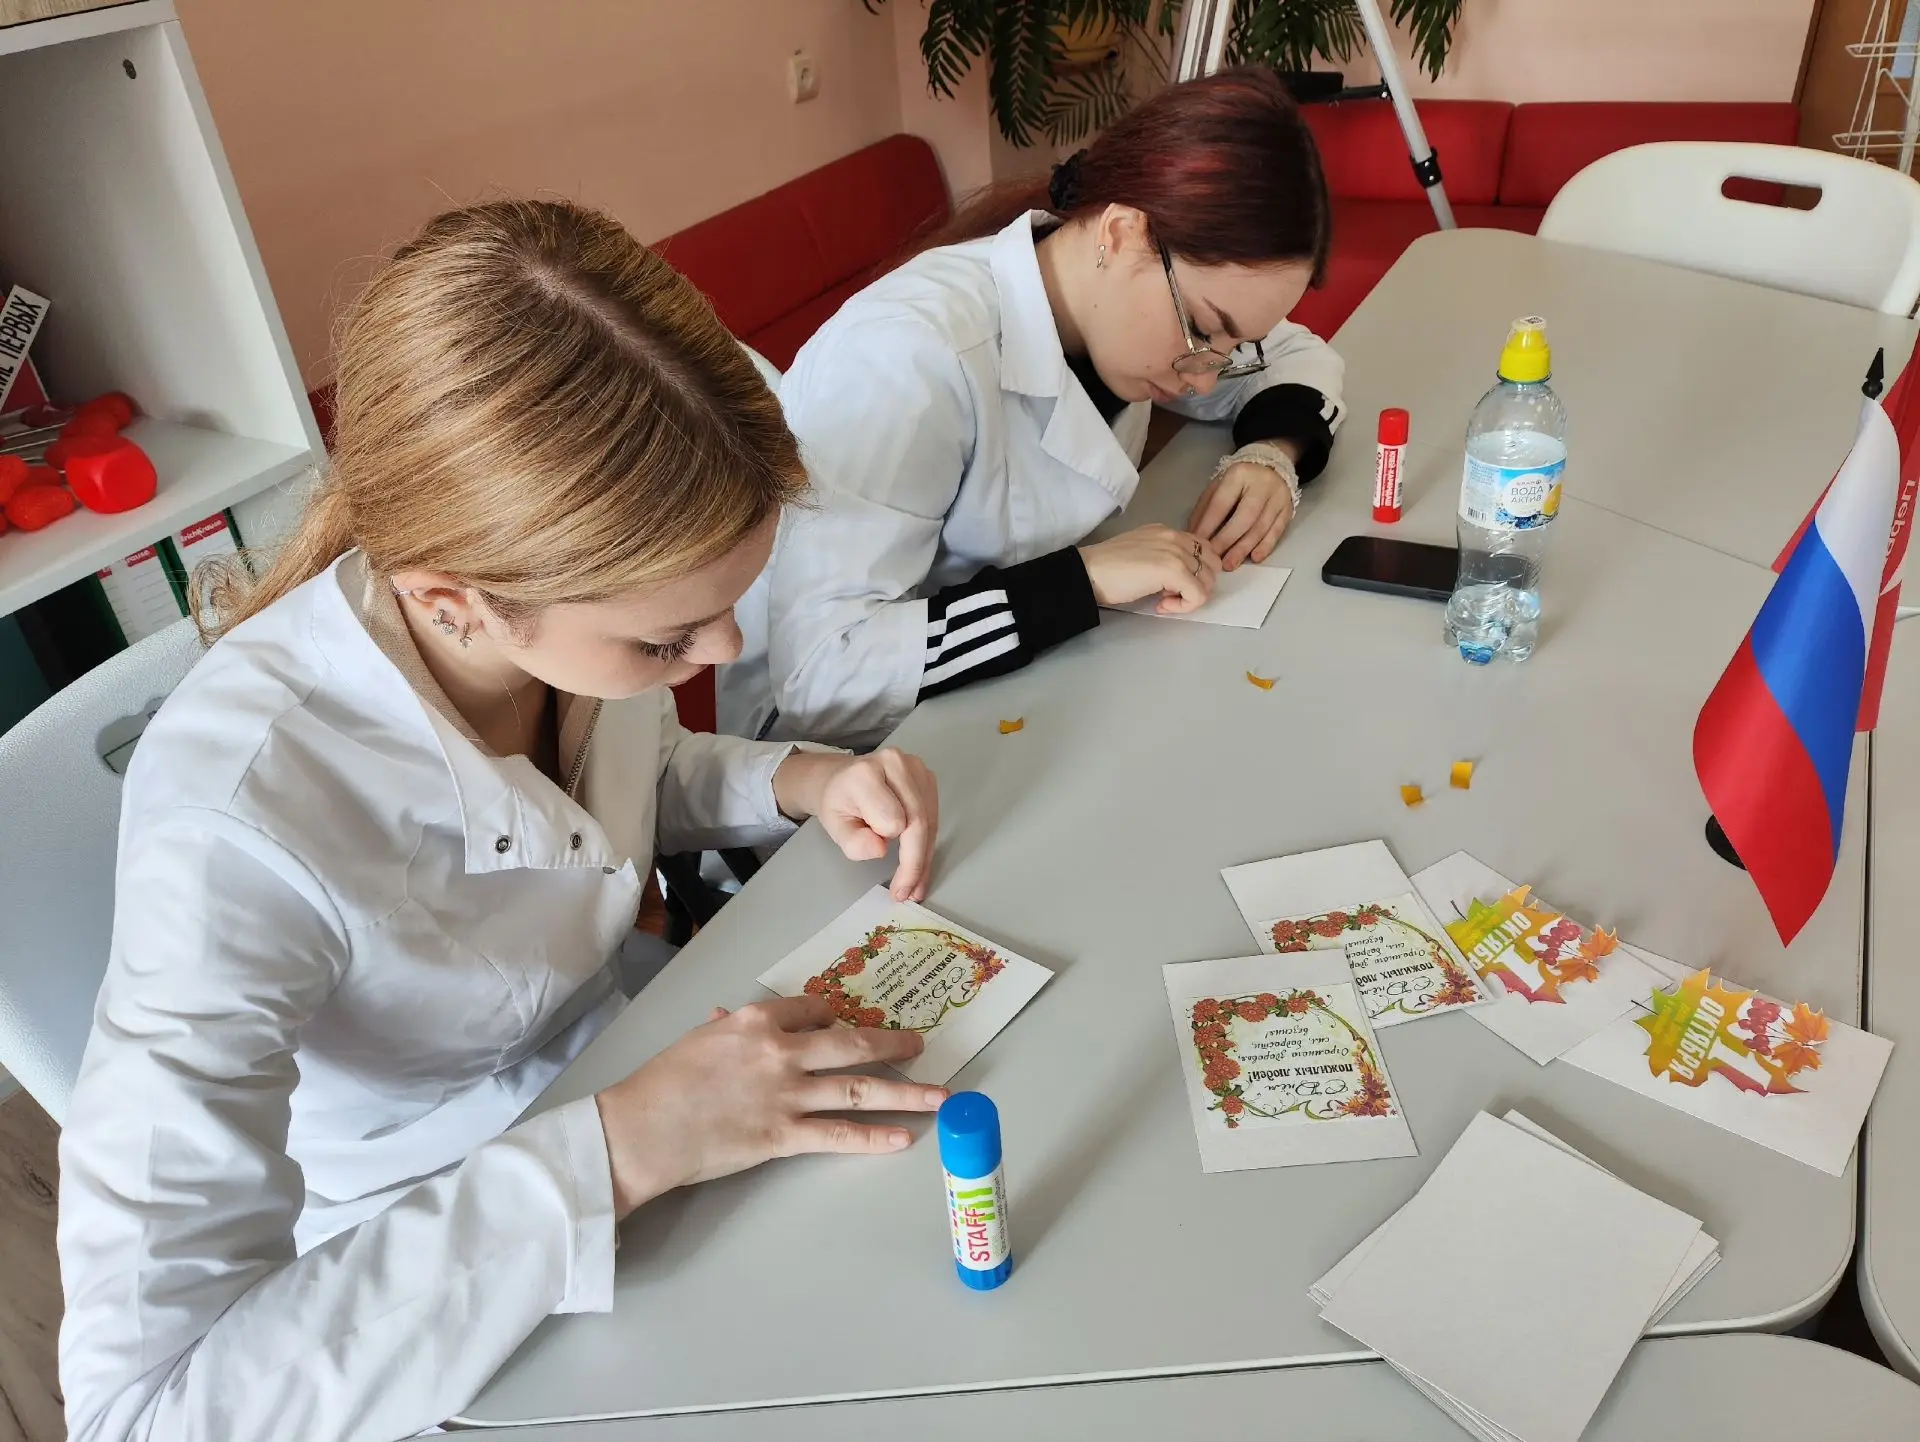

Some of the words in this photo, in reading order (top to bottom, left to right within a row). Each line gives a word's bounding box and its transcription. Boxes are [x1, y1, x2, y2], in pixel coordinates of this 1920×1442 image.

[0, 295, 42, 360] ПЕРВЫХ
[1511, 485, 1544, 496] ВОДА
[1511, 495, 1542, 504] АКТИВ
[1344, 935, 1384, 950] везения!
[1468, 911, 1532, 971] ОКТЯБР
[906, 944, 943, 977] Огромного
[1349, 957, 1369, 969] здор
[1374, 947, 1426, 964] Огромного
[918, 951, 957, 988] пожилых
[1380, 961, 1434, 980] пожилых
[1355, 973, 1378, 987] люд
[889, 986, 920, 1014] людей!
[1264, 1024, 1309, 1039] везения!
[1669, 996, 1725, 1081] ОКТЯБРЯ
[1308, 1036, 1330, 1044] сил,
[1238, 1050, 1287, 1064] здоровья,
[1291, 1045, 1349, 1058] Огромного
[1247, 1068, 1291, 1084] людей!
[1294, 1063, 1354, 1077] пожилых
[1264, 1079, 1322, 1096] Днём
[1325, 1078, 1349, 1094] С
[964, 1207, 990, 1262] STAFF
